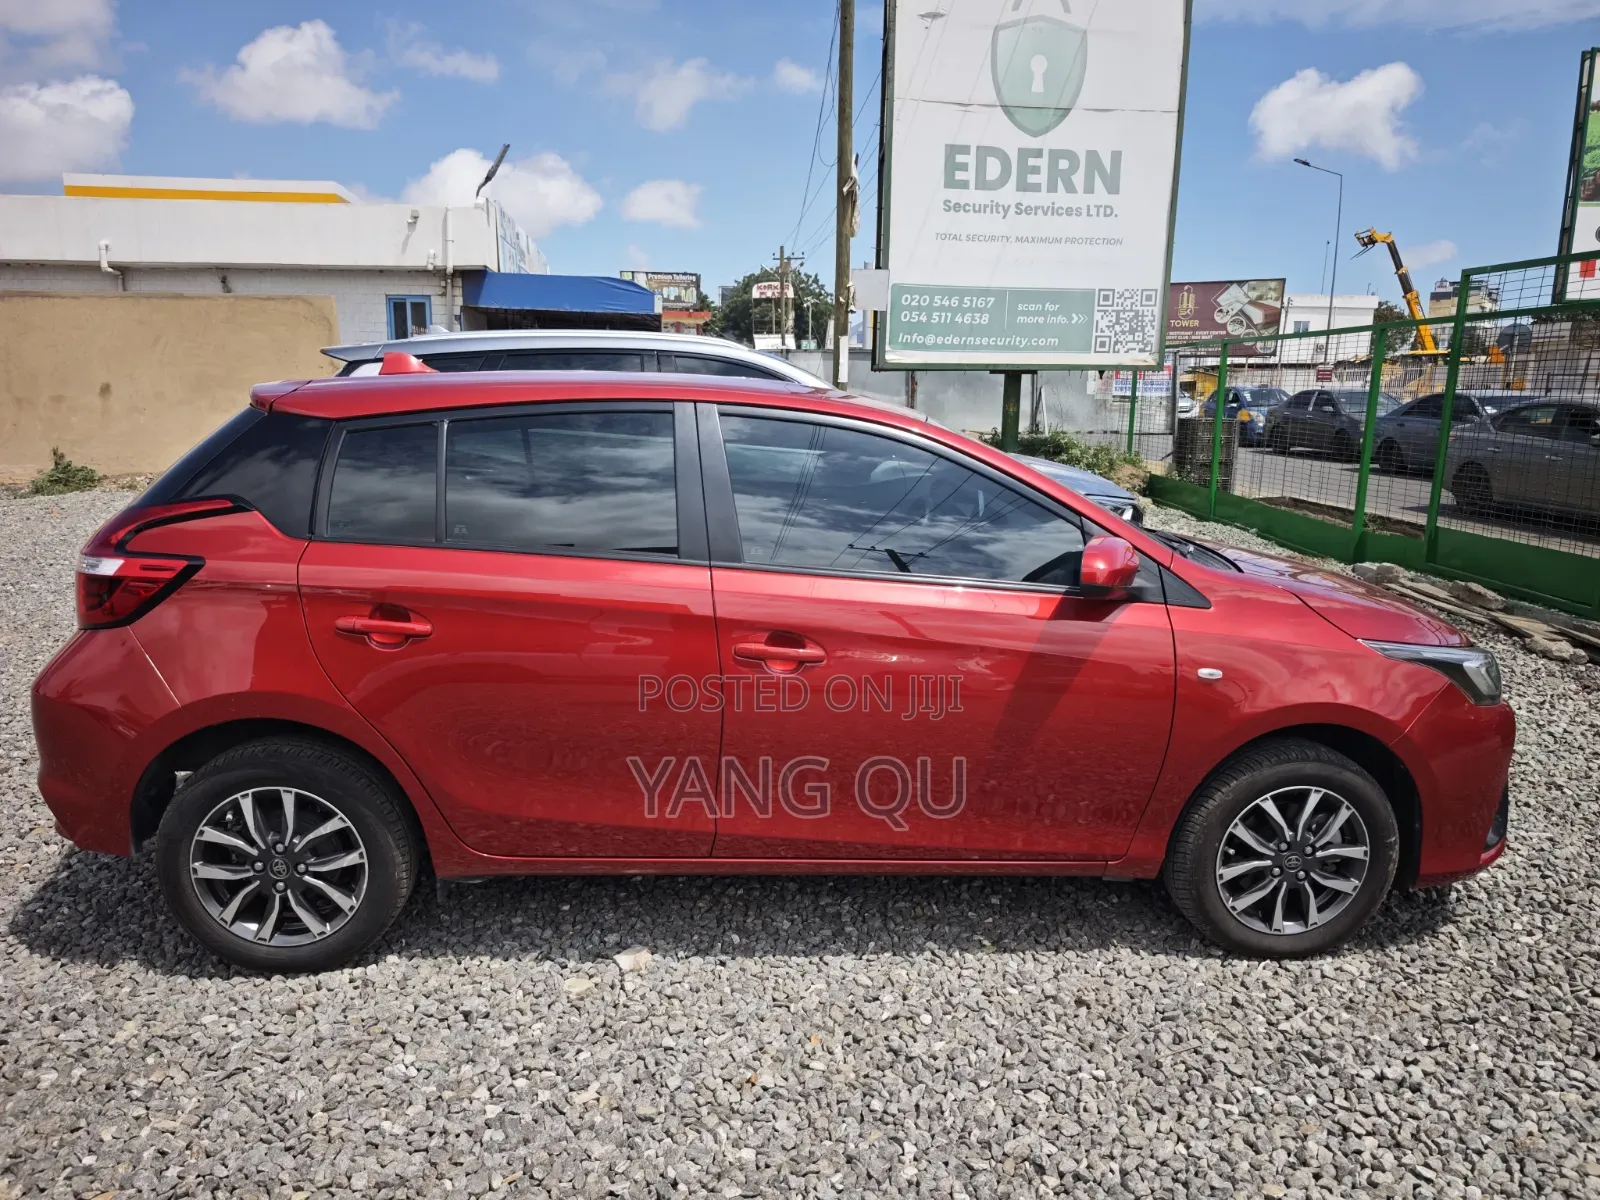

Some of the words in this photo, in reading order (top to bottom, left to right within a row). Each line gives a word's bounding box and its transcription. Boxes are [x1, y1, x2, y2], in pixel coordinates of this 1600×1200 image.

[943, 143, 1123, 195] EDERN
[942, 199, 1011, 219] Security
[1014, 202, 1082, 217] Services
[1086, 204, 1118, 218] LTD.
[935, 232, 963, 242] TOTAL
[965, 234, 1012, 244] SECURITY,
[1015, 235, 1062, 245] MAXIMUM
[1064, 237, 1123, 246] PROTECTION
[901, 294, 929, 306] 020
[932, 296, 959, 307] 546
[962, 296, 995, 308] 5167
[1017, 303, 1042, 311] scan
[1044, 302, 1059, 311] for
[900, 311, 927, 323] 054
[930, 312, 951, 323] 511
[954, 312, 989, 324] 4638
[1016, 315, 1044, 323] more
[1046, 314, 1069, 324] info.
[1169, 319, 1199, 327] TOWER
